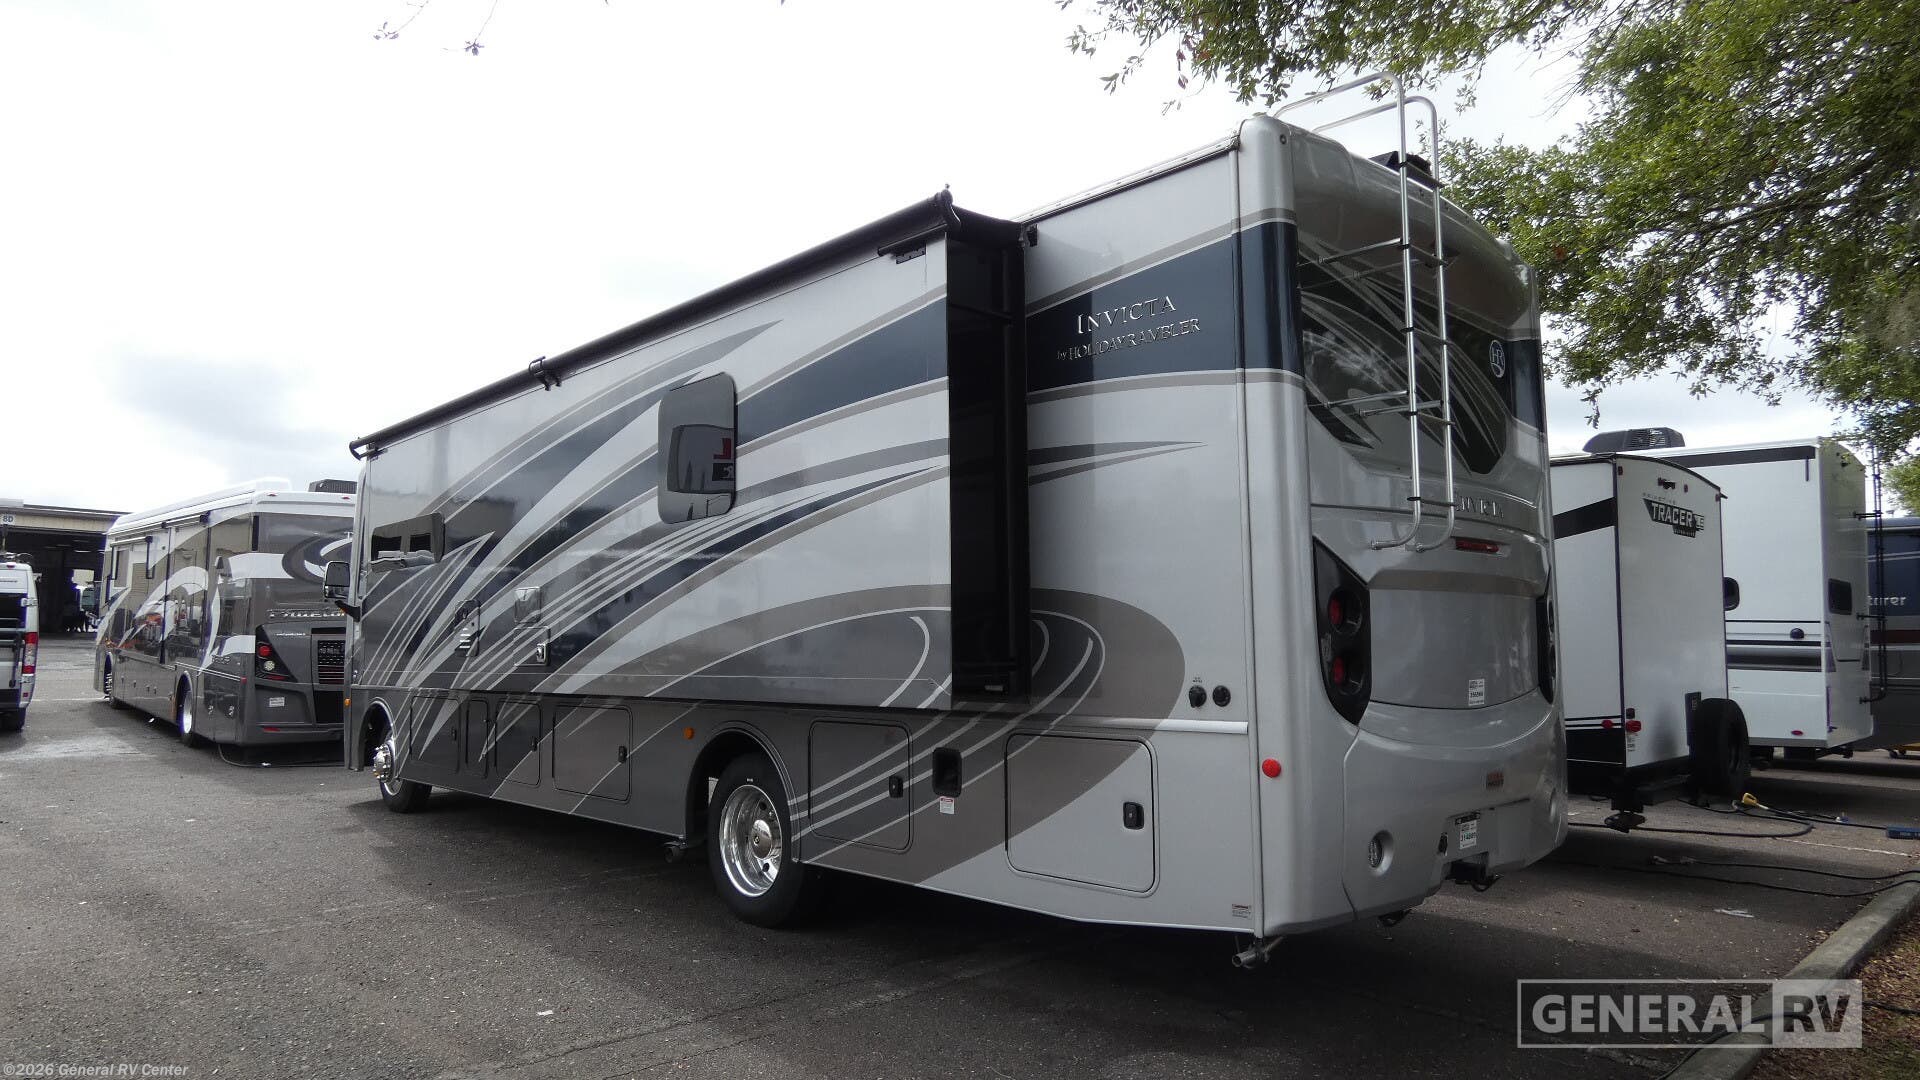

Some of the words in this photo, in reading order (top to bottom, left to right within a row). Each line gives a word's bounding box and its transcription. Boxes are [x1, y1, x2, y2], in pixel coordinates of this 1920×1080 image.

[1077, 295, 1177, 334] INVICTA
[1057, 350, 1067, 361] by
[1651, 502, 1694, 527] TRACER
